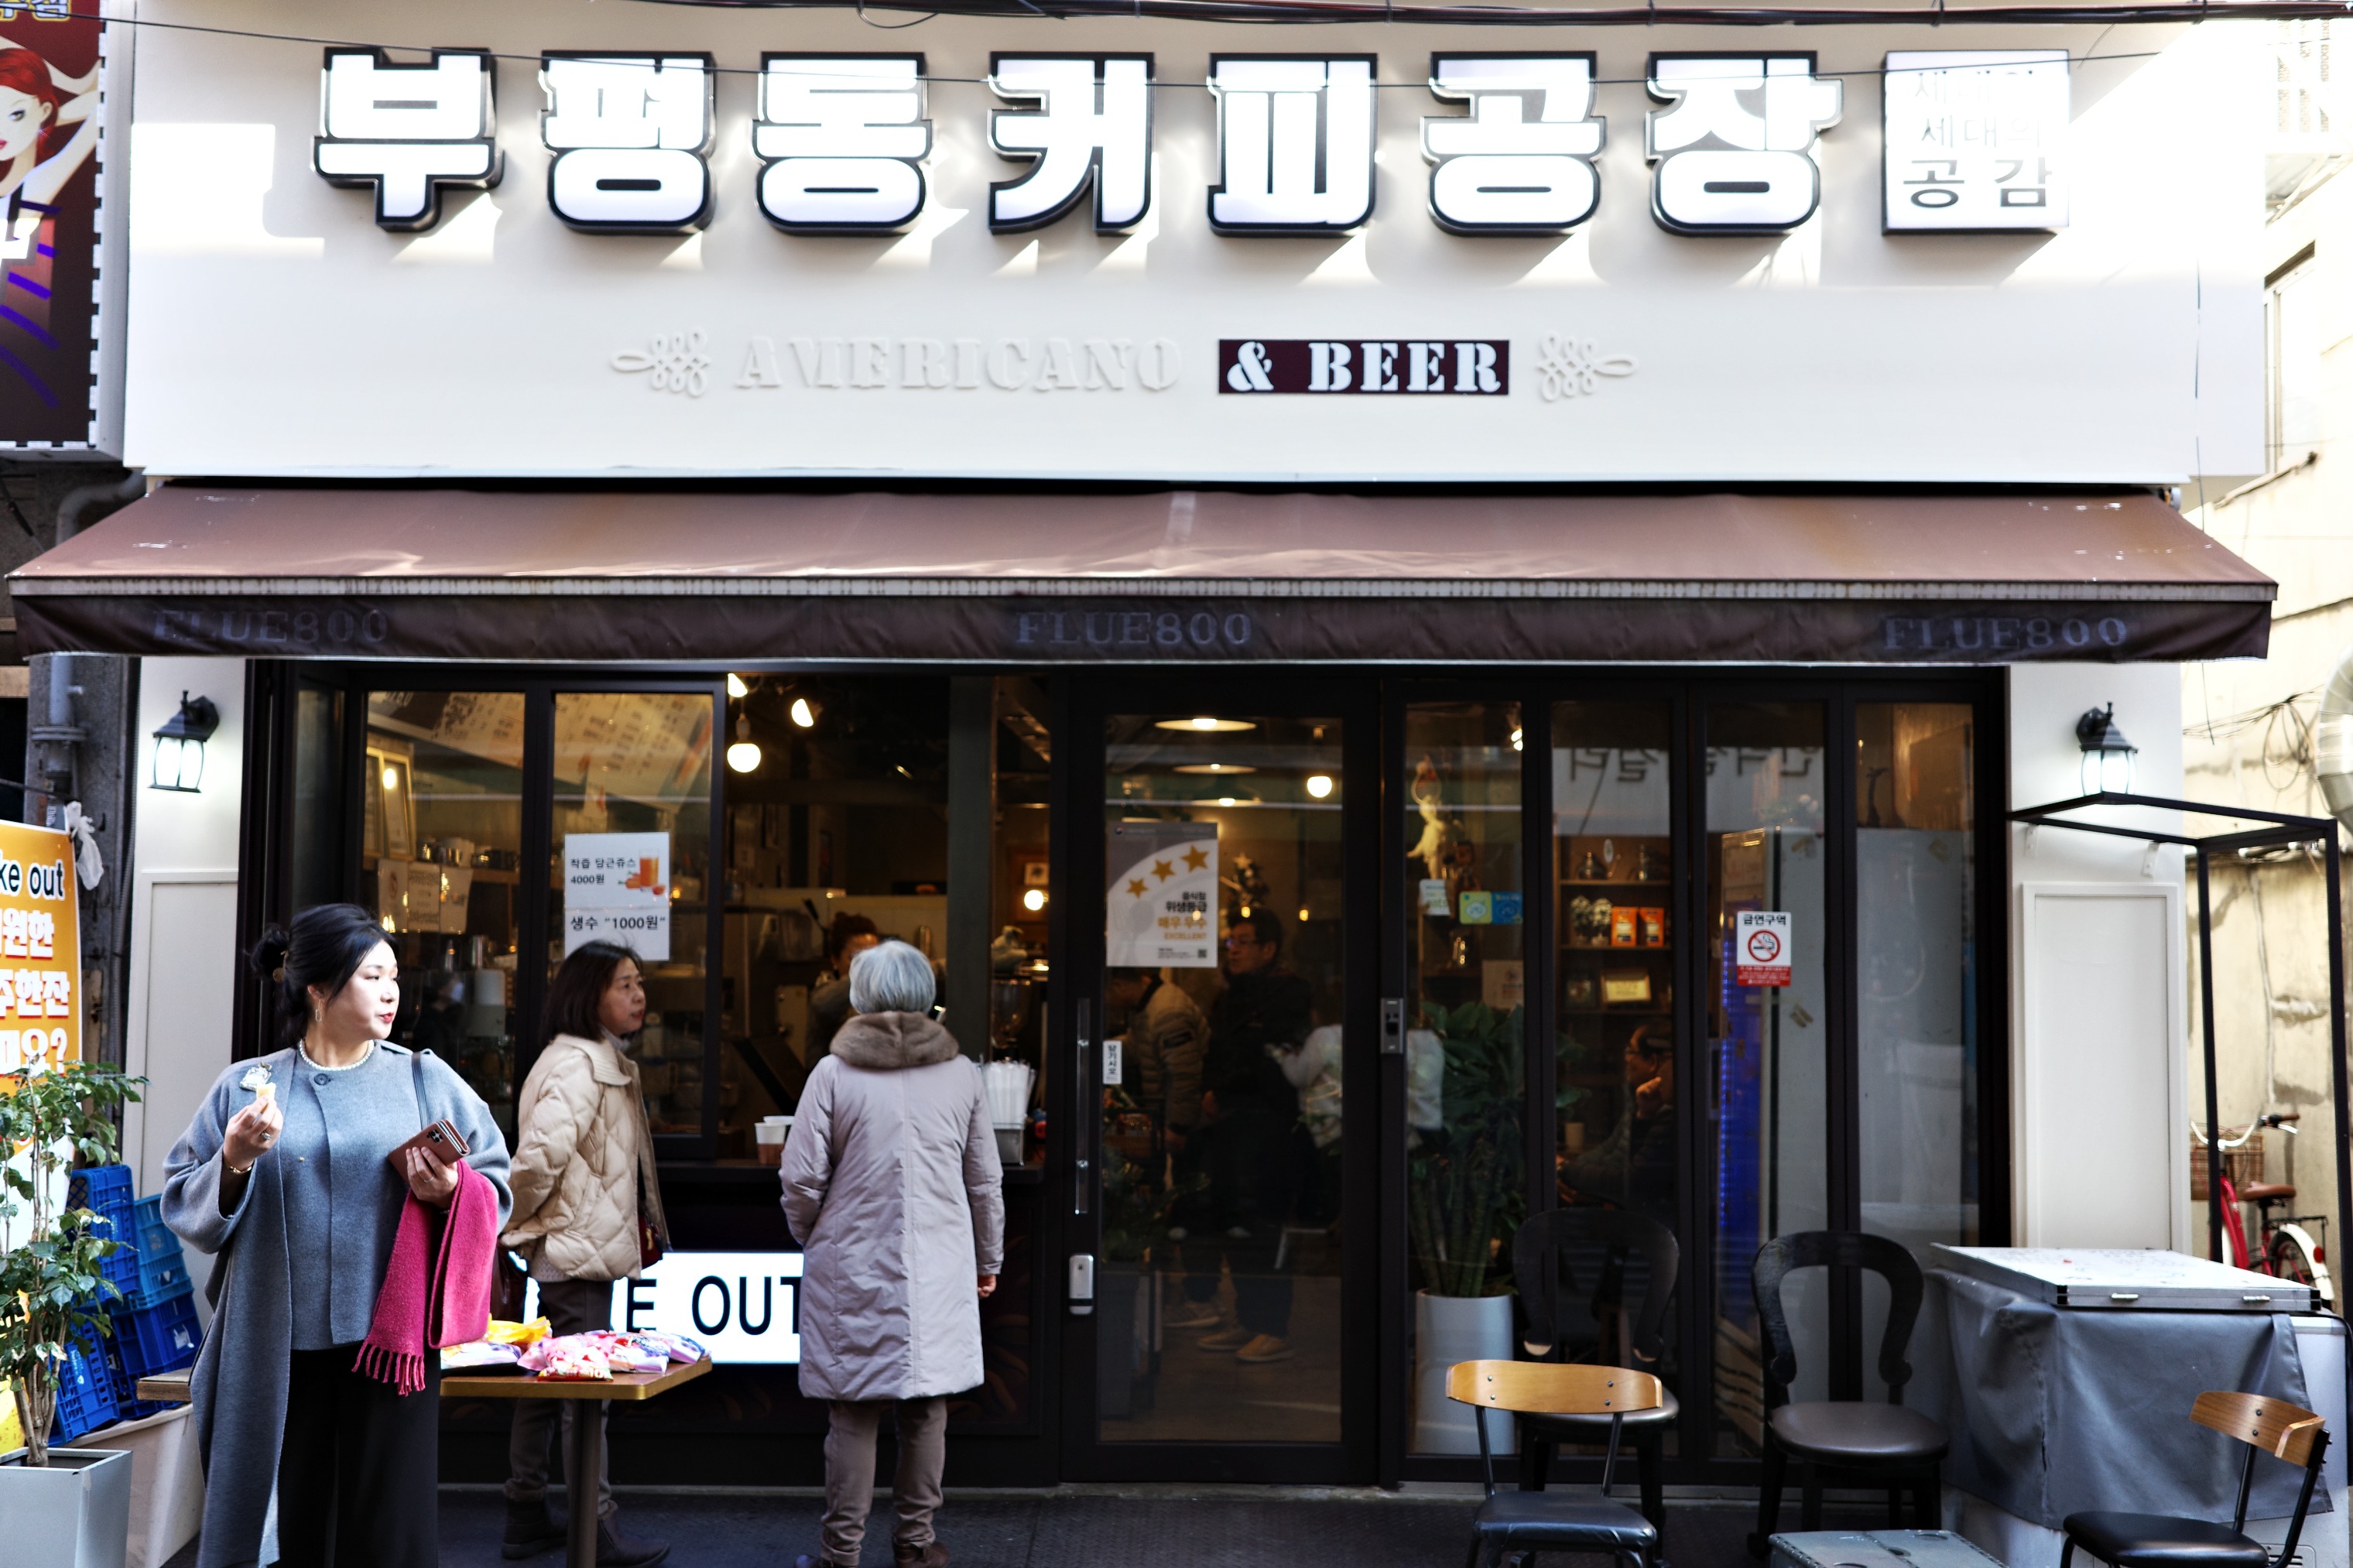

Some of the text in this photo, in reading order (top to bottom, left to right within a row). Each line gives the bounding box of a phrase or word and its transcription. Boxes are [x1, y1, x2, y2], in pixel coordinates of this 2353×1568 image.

[1903, 156, 2053, 208] 공감
[736, 337, 1502, 392] AMERICANO & BEER
[1016, 612, 1252, 645] FLUE800
[1882, 618, 2128, 650] FLUE800
[29, 861, 64, 897] out
[570, 873, 605, 885] 4000원
[0, 907, 55, 960] 원한
[571, 916, 598, 931] 생수
[1743, 914, 1786, 926] 금연구역
